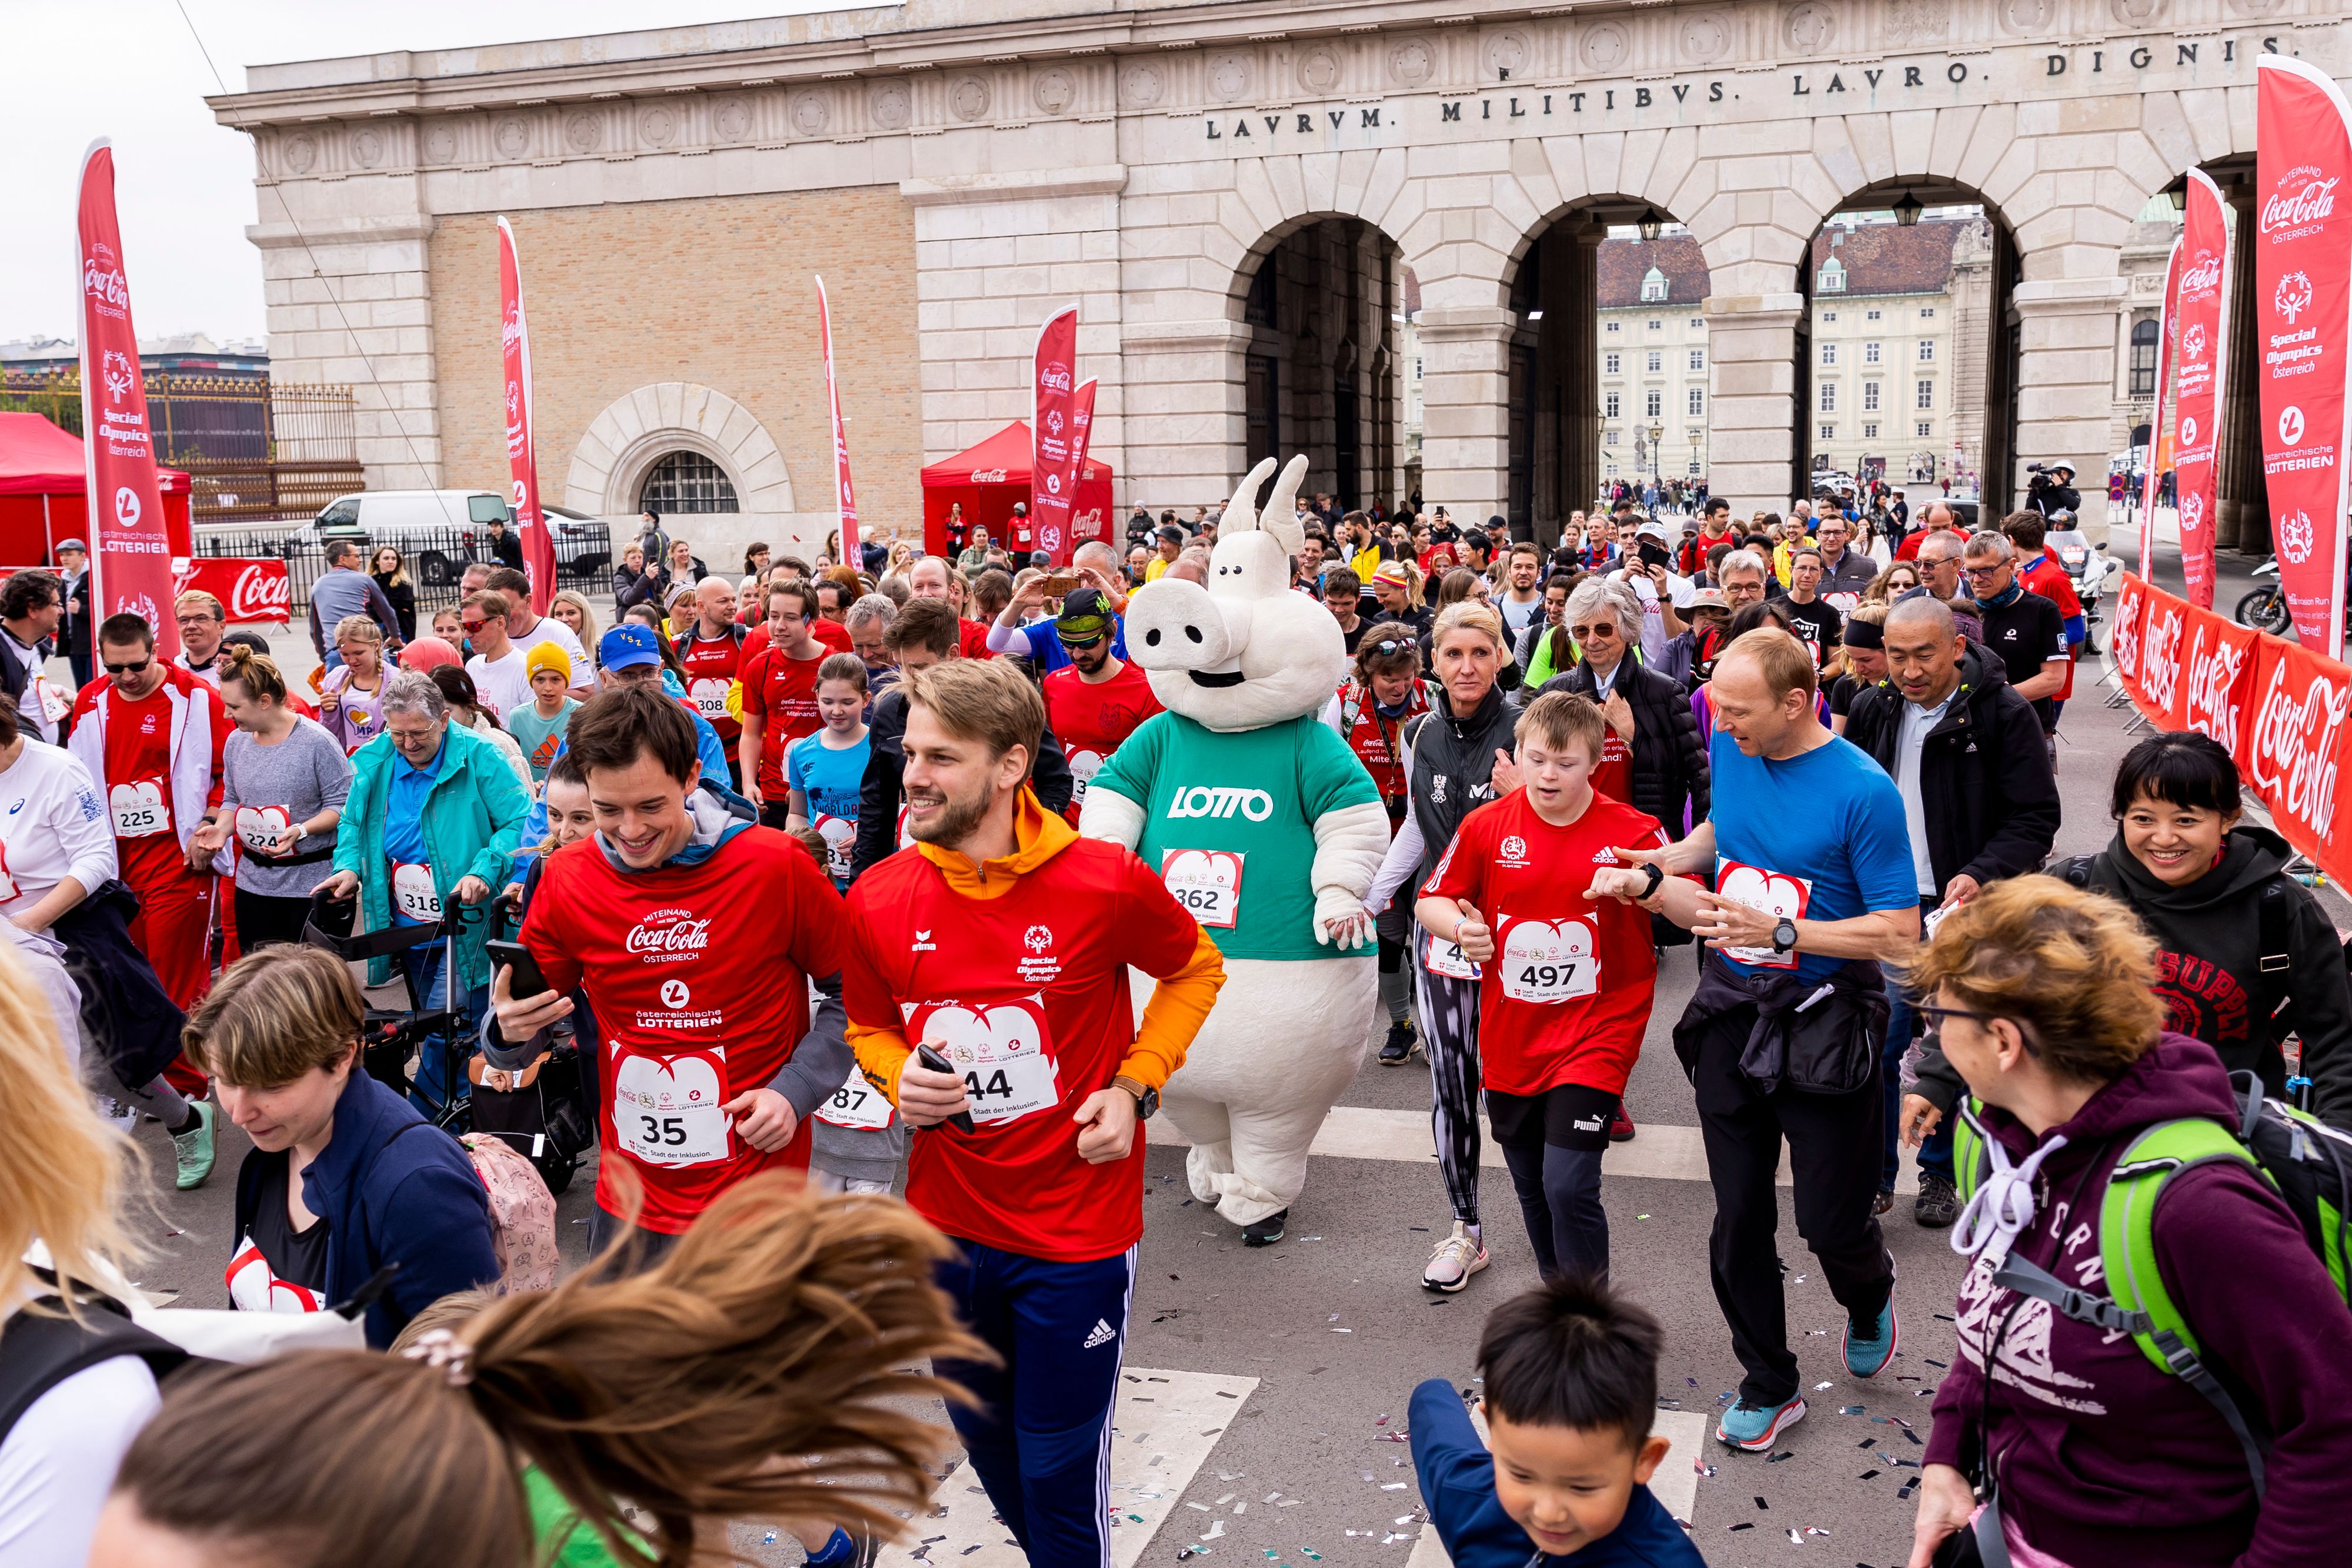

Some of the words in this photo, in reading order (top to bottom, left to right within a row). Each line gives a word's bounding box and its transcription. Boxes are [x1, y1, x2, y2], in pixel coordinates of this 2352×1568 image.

[1207, 108, 1395, 139] LAVRVM.
[1442, 81, 1740, 122] MILITIBVS.
[1793, 62, 1989, 95] LAVRO.
[2277, 165, 2321, 189] MITEINAND
[2260, 176, 2341, 233] Coca-Cola
[2273, 223, 2324, 244] ÖSTERREICH
[2270, 327, 2317, 348] Special
[2266, 345, 2323, 365] Olympics
[2180, 362, 2209, 376] Special
[2273, 360, 2315, 379] Österreich
[104, 408, 142, 425] Special
[99, 424, 148, 443] Olympics
[2176, 452, 2213, 467] OTTERIEN
[2265, 444, 2334, 462] österreichische
[2266, 455, 2334, 474] LOTTERIEN
[971, 469, 1008, 482] Coca-Cola
[1037, 498, 1069, 509] OTTERIEN
[2289, 551, 2306, 564] VCM
[2315, 597, 2330, 606] Run
[698, 700, 723, 711] 308
[1167, 786, 1274, 822] LOTTO
[120, 810, 155, 827] 225
[246, 833, 278, 848] 224
[405, 894, 441, 912] 318
[1175, 889, 1218, 910] 362
[643, 908, 691, 923] MITEINAND
[626, 918, 711, 953] Coca-Cola
[912, 942, 936, 951] erima
[1507, 948, 1528, 958] Coca-Cola
[643, 951, 699, 963] ÖSTERREICH
[1021, 957, 1057, 966] Special
[1753, 951, 1780, 961] Inklusion.
[1017, 966, 1061, 974] Olympics
[1519, 963, 1576, 987] 497
[1024, 974, 1055, 982] Österreich
[2155, 950, 2248, 1040] SUPPLY
[636, 1009, 721, 1018] österreichische
[637, 1017, 722, 1028] LOTTERIEN
[999, 1050, 1035, 1062] LOTTERIEN
[619, 1086, 636, 1102] Coca-Cola
[833, 1088, 868, 1111] 87
[1006, 1101, 1041, 1112] Inklusion.
[640, 1115, 687, 1145] 35
[1573, 1119, 1601, 1132] PUMA
[636, 1148, 647, 1156] Wien
[1084, 1329, 1117, 1348] adidas
